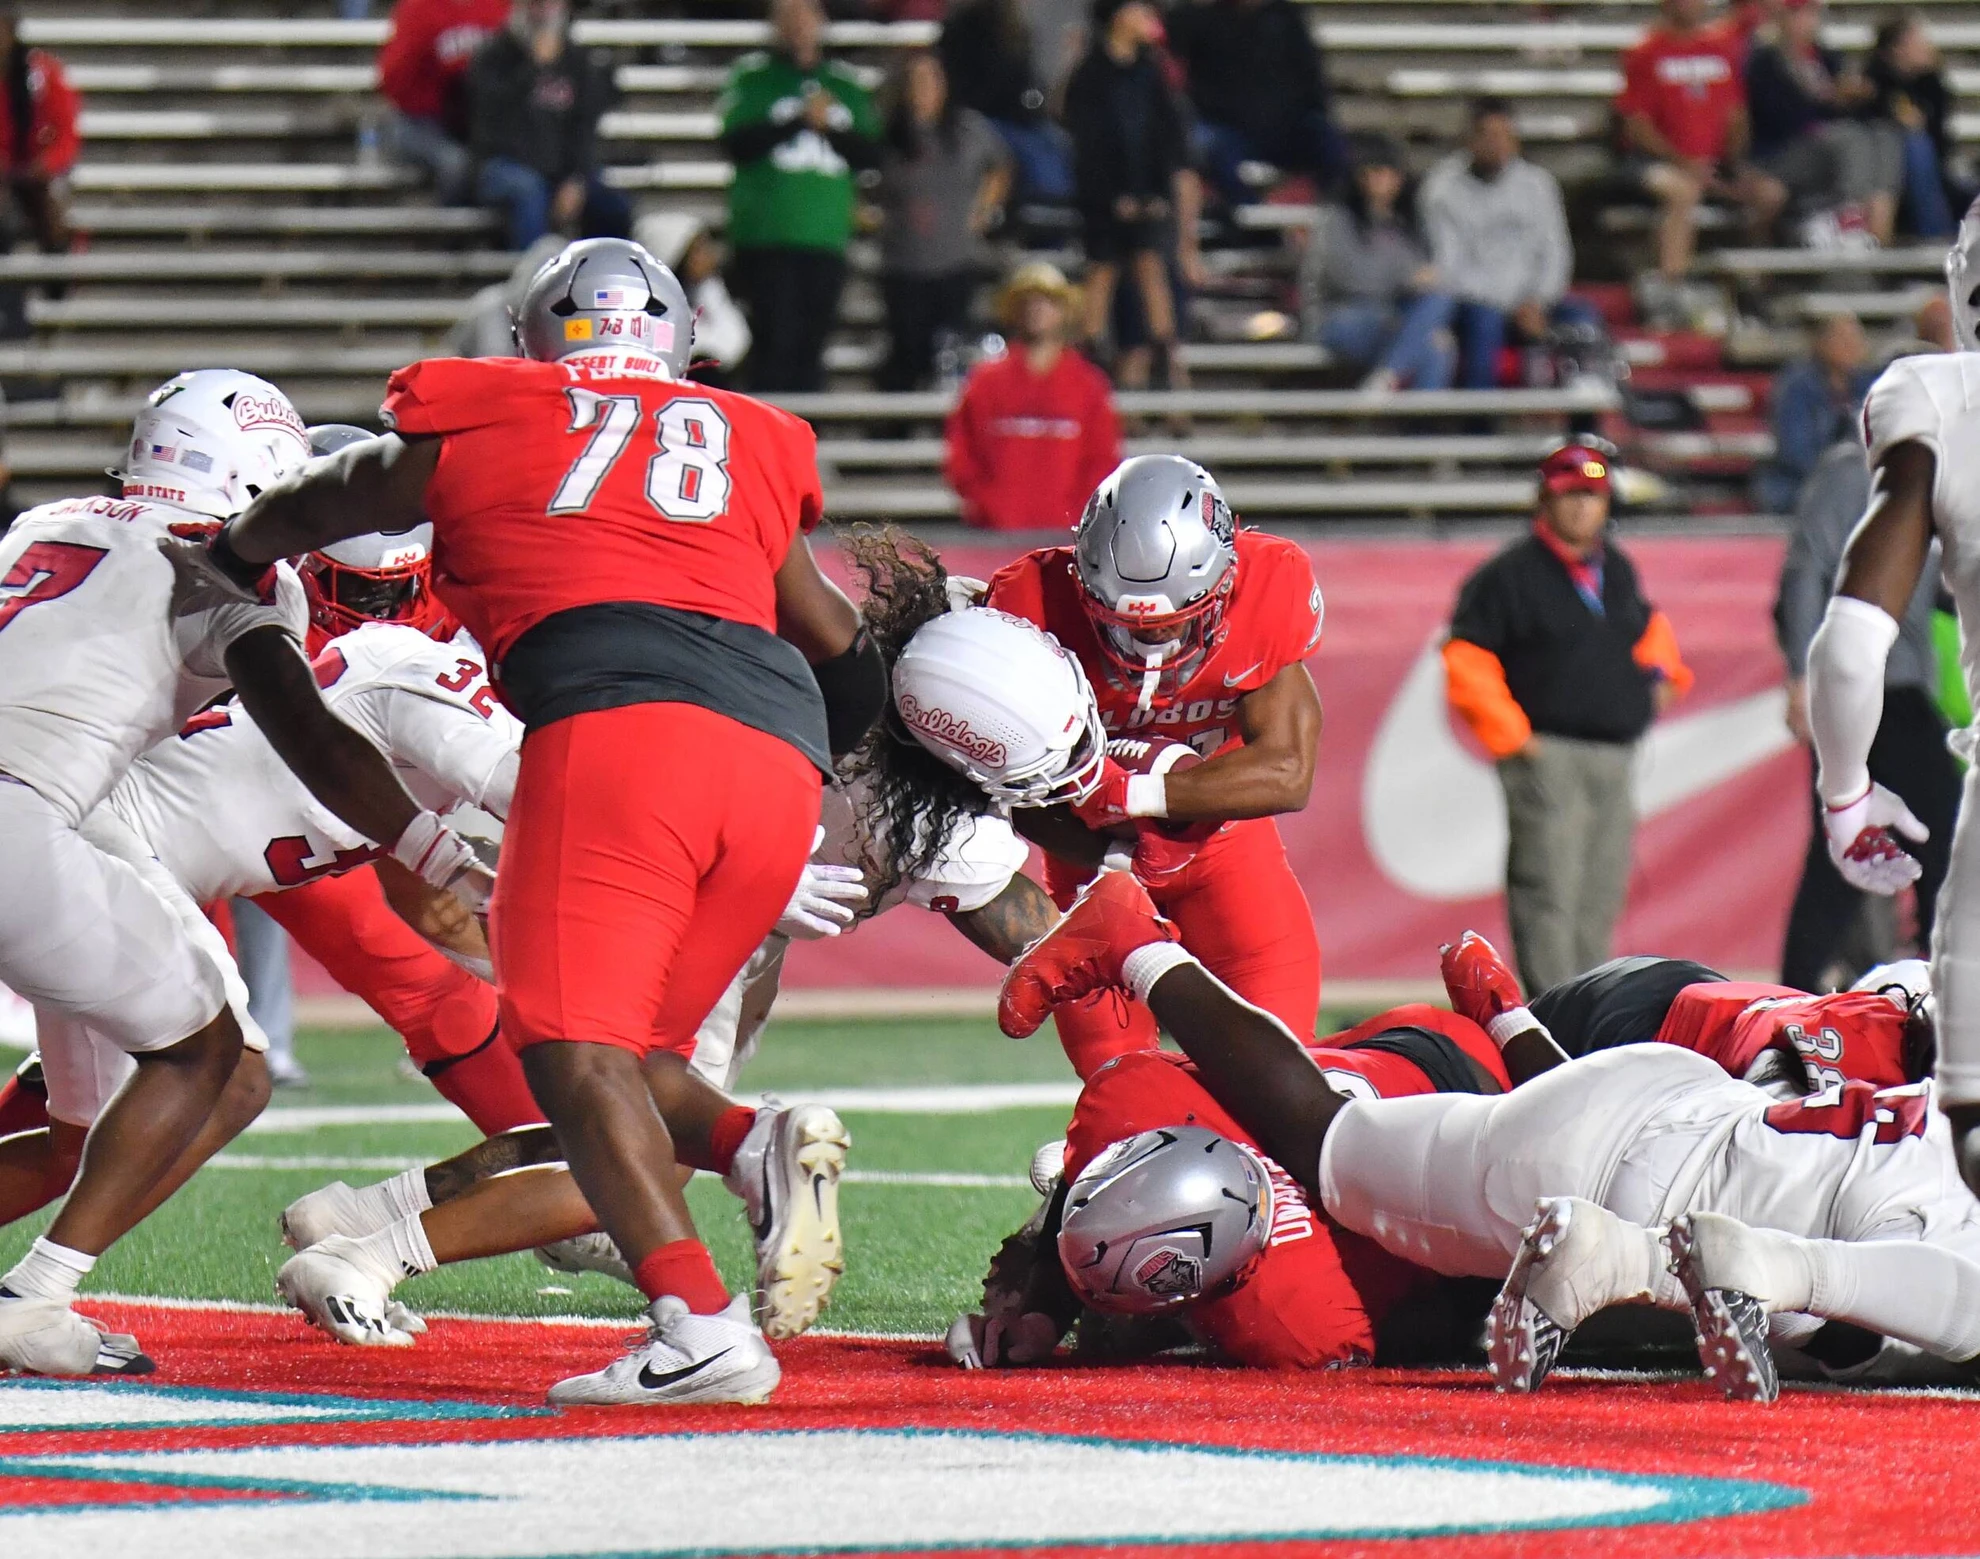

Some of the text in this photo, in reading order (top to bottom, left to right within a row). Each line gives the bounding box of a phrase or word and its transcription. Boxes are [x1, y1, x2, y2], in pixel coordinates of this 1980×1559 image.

[624, 356, 661, 373] BUILT
[545, 387, 733, 522] 78
[147, 485, 186, 502] STATE
[900, 694, 1007, 768] Bulldogs
